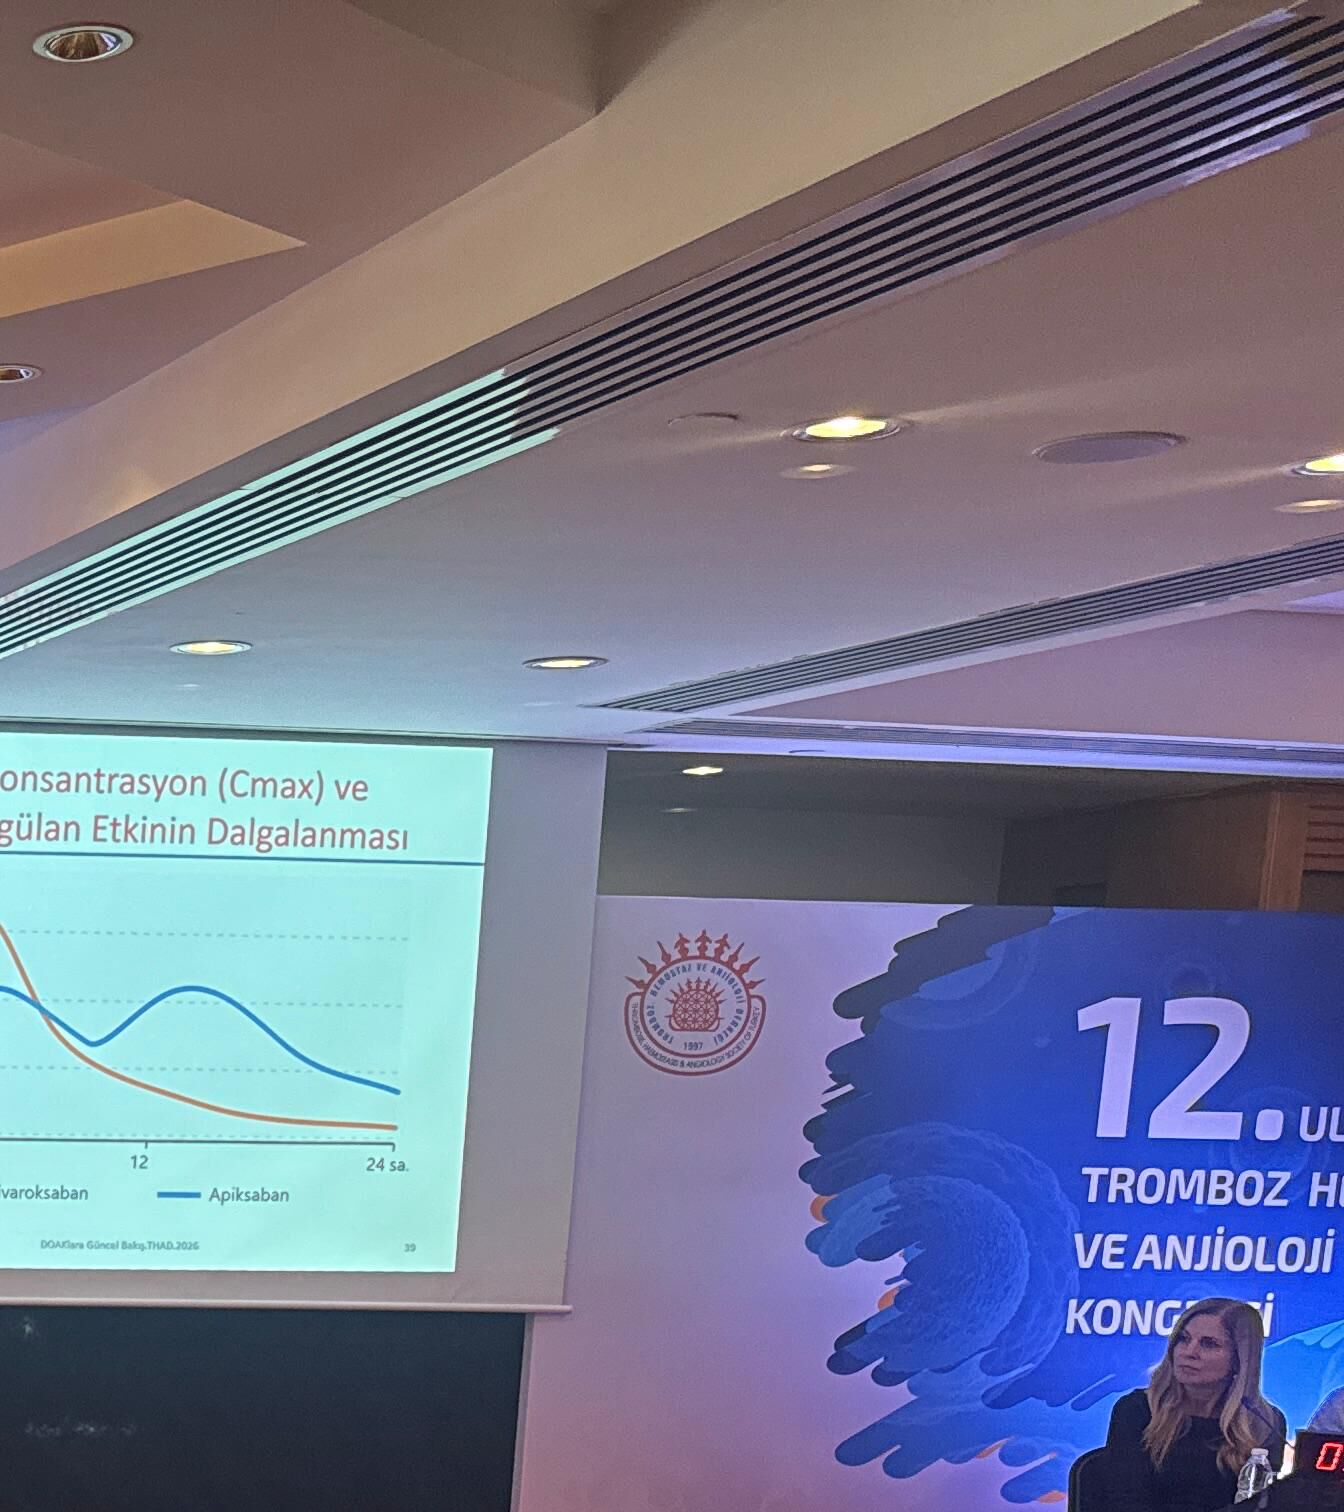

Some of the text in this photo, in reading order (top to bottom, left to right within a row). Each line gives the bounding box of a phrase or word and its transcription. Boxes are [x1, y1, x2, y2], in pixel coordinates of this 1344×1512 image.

[218, 767, 324, 806] (Cmax)
[334, 779, 369, 801] ve
[92, 814, 196, 845] Etkinin
[207, 817, 408, 853] Dalgalanması
[1077, 996, 1285, 1141] 12.
[130, 1155, 149, 1169] 12
[366, 1157, 410, 1172] 24 sa.
[208, 1187, 290, 1205] Apiksaban
[1081, 1167, 1344, 1208] TROMBOZ H
[86, 1240, 119, 1250] Güncel
[1074, 1226, 1336, 1273] VE ANJİOLOJİ
[1065, 1292, 1275, 1338] KONGİ
